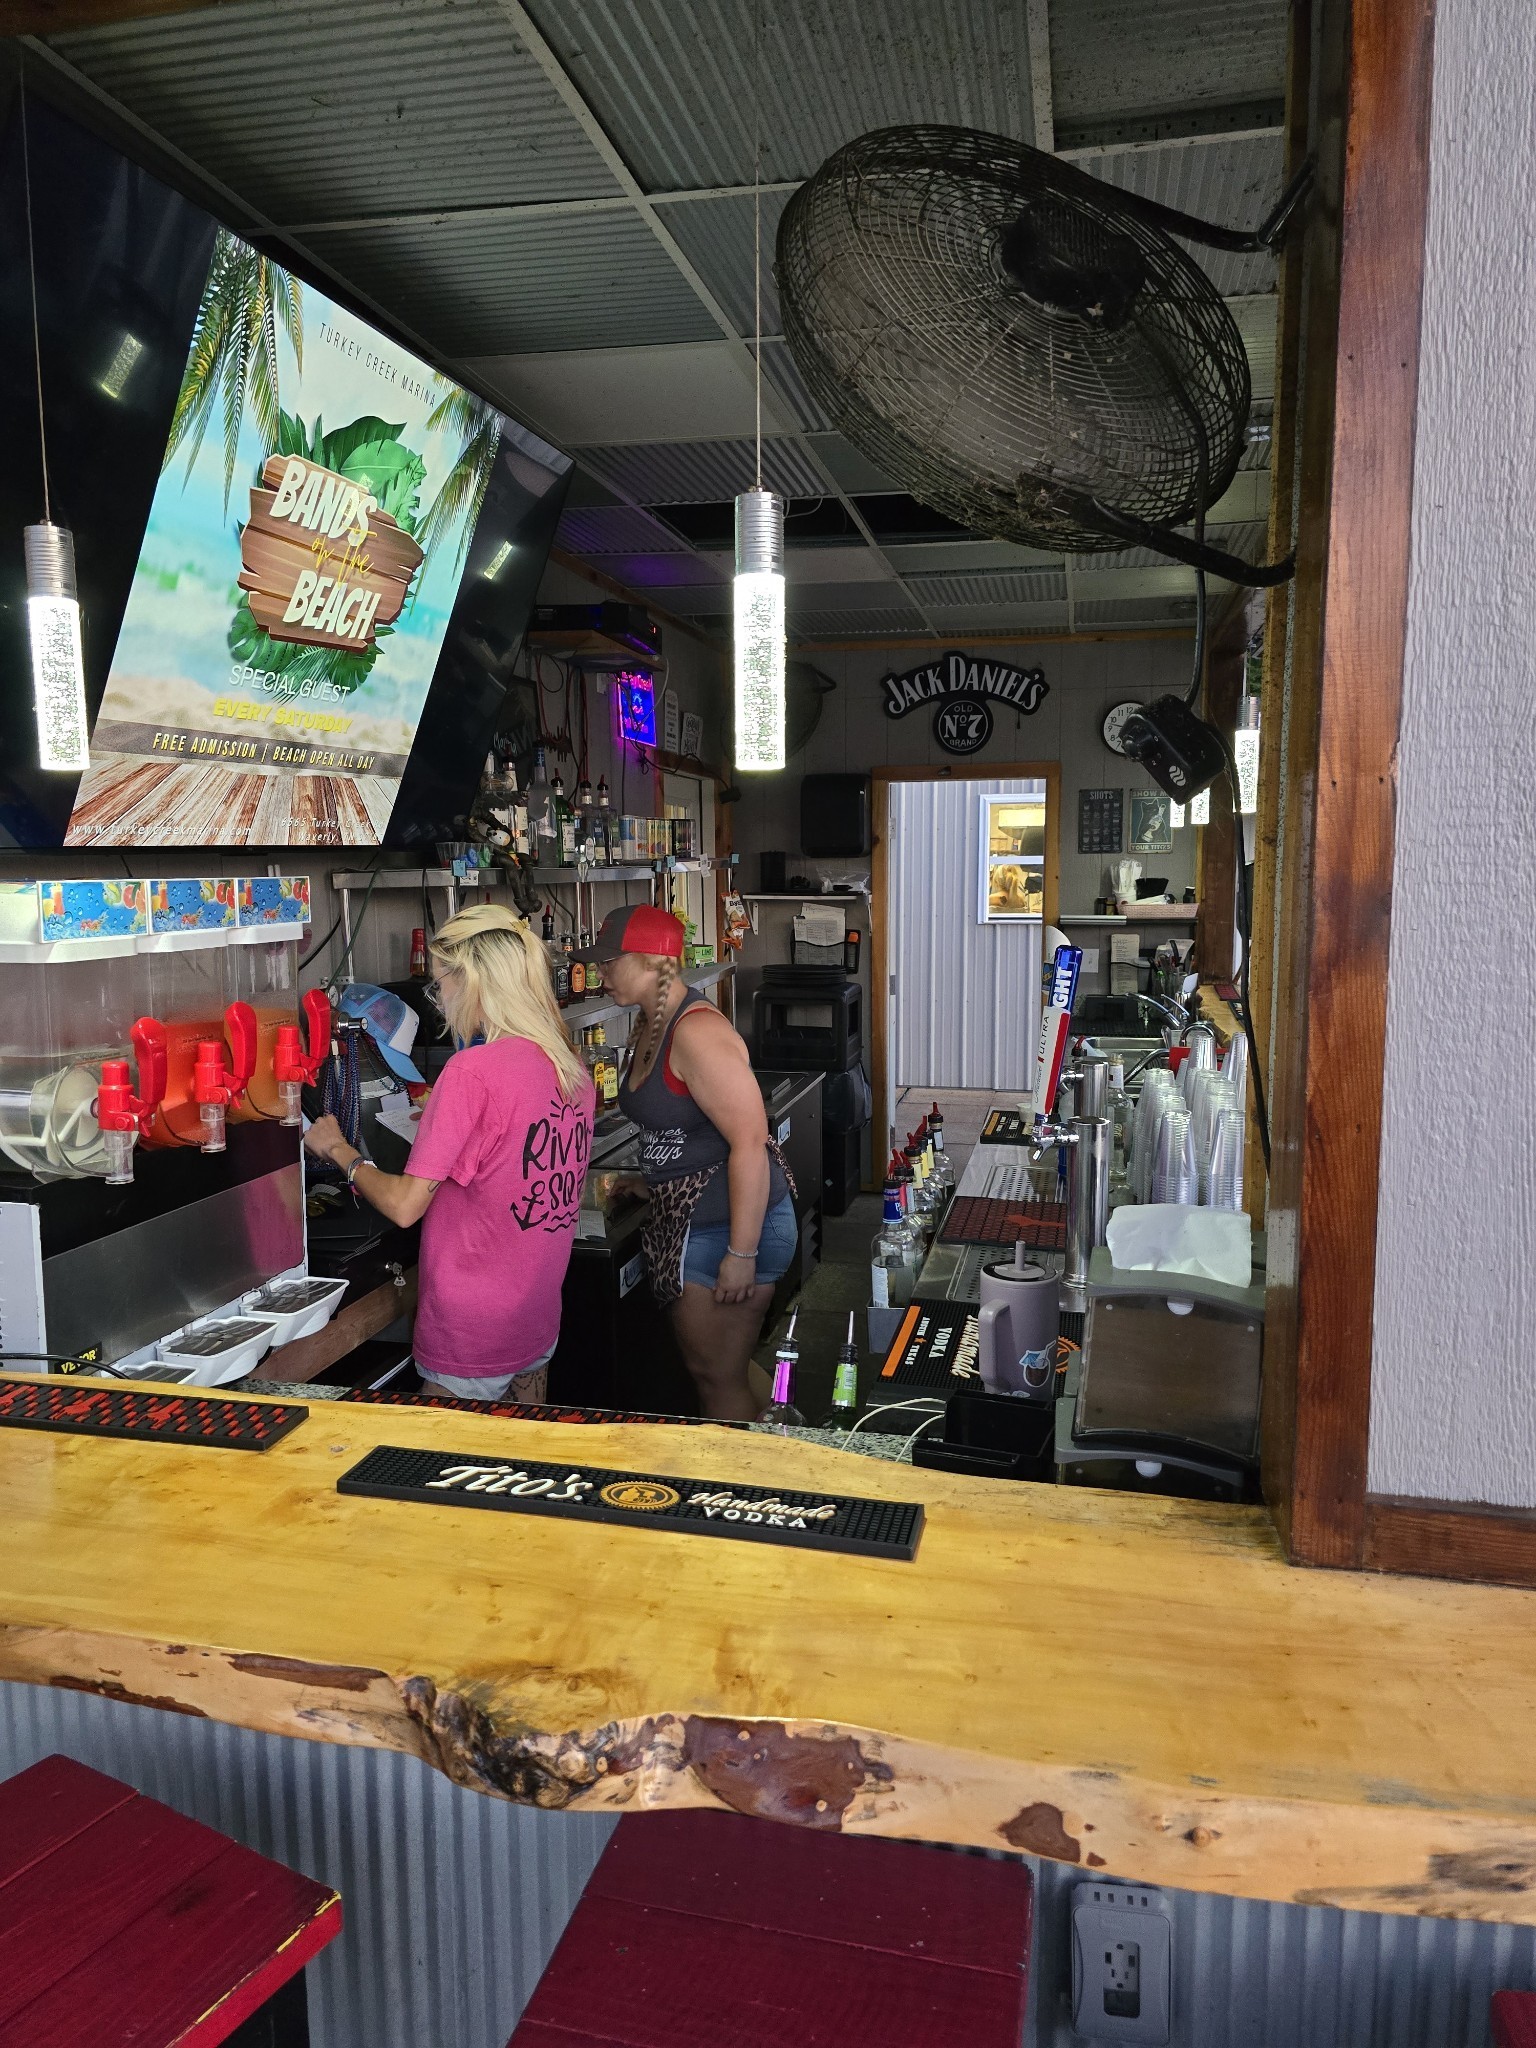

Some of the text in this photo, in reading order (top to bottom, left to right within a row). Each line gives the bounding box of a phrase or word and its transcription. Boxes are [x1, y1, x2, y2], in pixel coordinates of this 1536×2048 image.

[320, 322, 436, 408] TURKEY CREEK MARINA
[269, 460, 377, 546] BANDS
[282, 569, 382, 640] BEACH
[229, 664, 350, 704] SPECIAL GUEST
[886, 655, 1045, 714] JACK DANIEL'S
[213, 697, 353, 734] EVERY SATURDAY
[953, 703, 973, 713] OLD
[1126, 706, 1134, 714] 12
[152, 732, 187, 752] FREE
[190, 736, 258, 758] ADMISSION
[272, 745, 306, 763] BEACH
[309, 749, 335, 766] OPEN
[337, 753, 354, 768] ALL
[357, 755, 375, 770] DAY
[949, 738, 978, 748] BRAND
[1116, 741, 1122, 749] 7
[1089, 790, 1114, 800] SHOTS
[72, 820, 252, 837] www.turkeycreekmarina.com
[1039, 1015, 1050, 1055] ULTRA
[928, 1327, 952, 1359] VODKA
[61, 1348, 97, 1374] VEOR
[425, 1464, 594, 1501] Tito's
[687, 1491, 838, 1521] Handmade
[703, 1506, 808, 1529] VODKA
